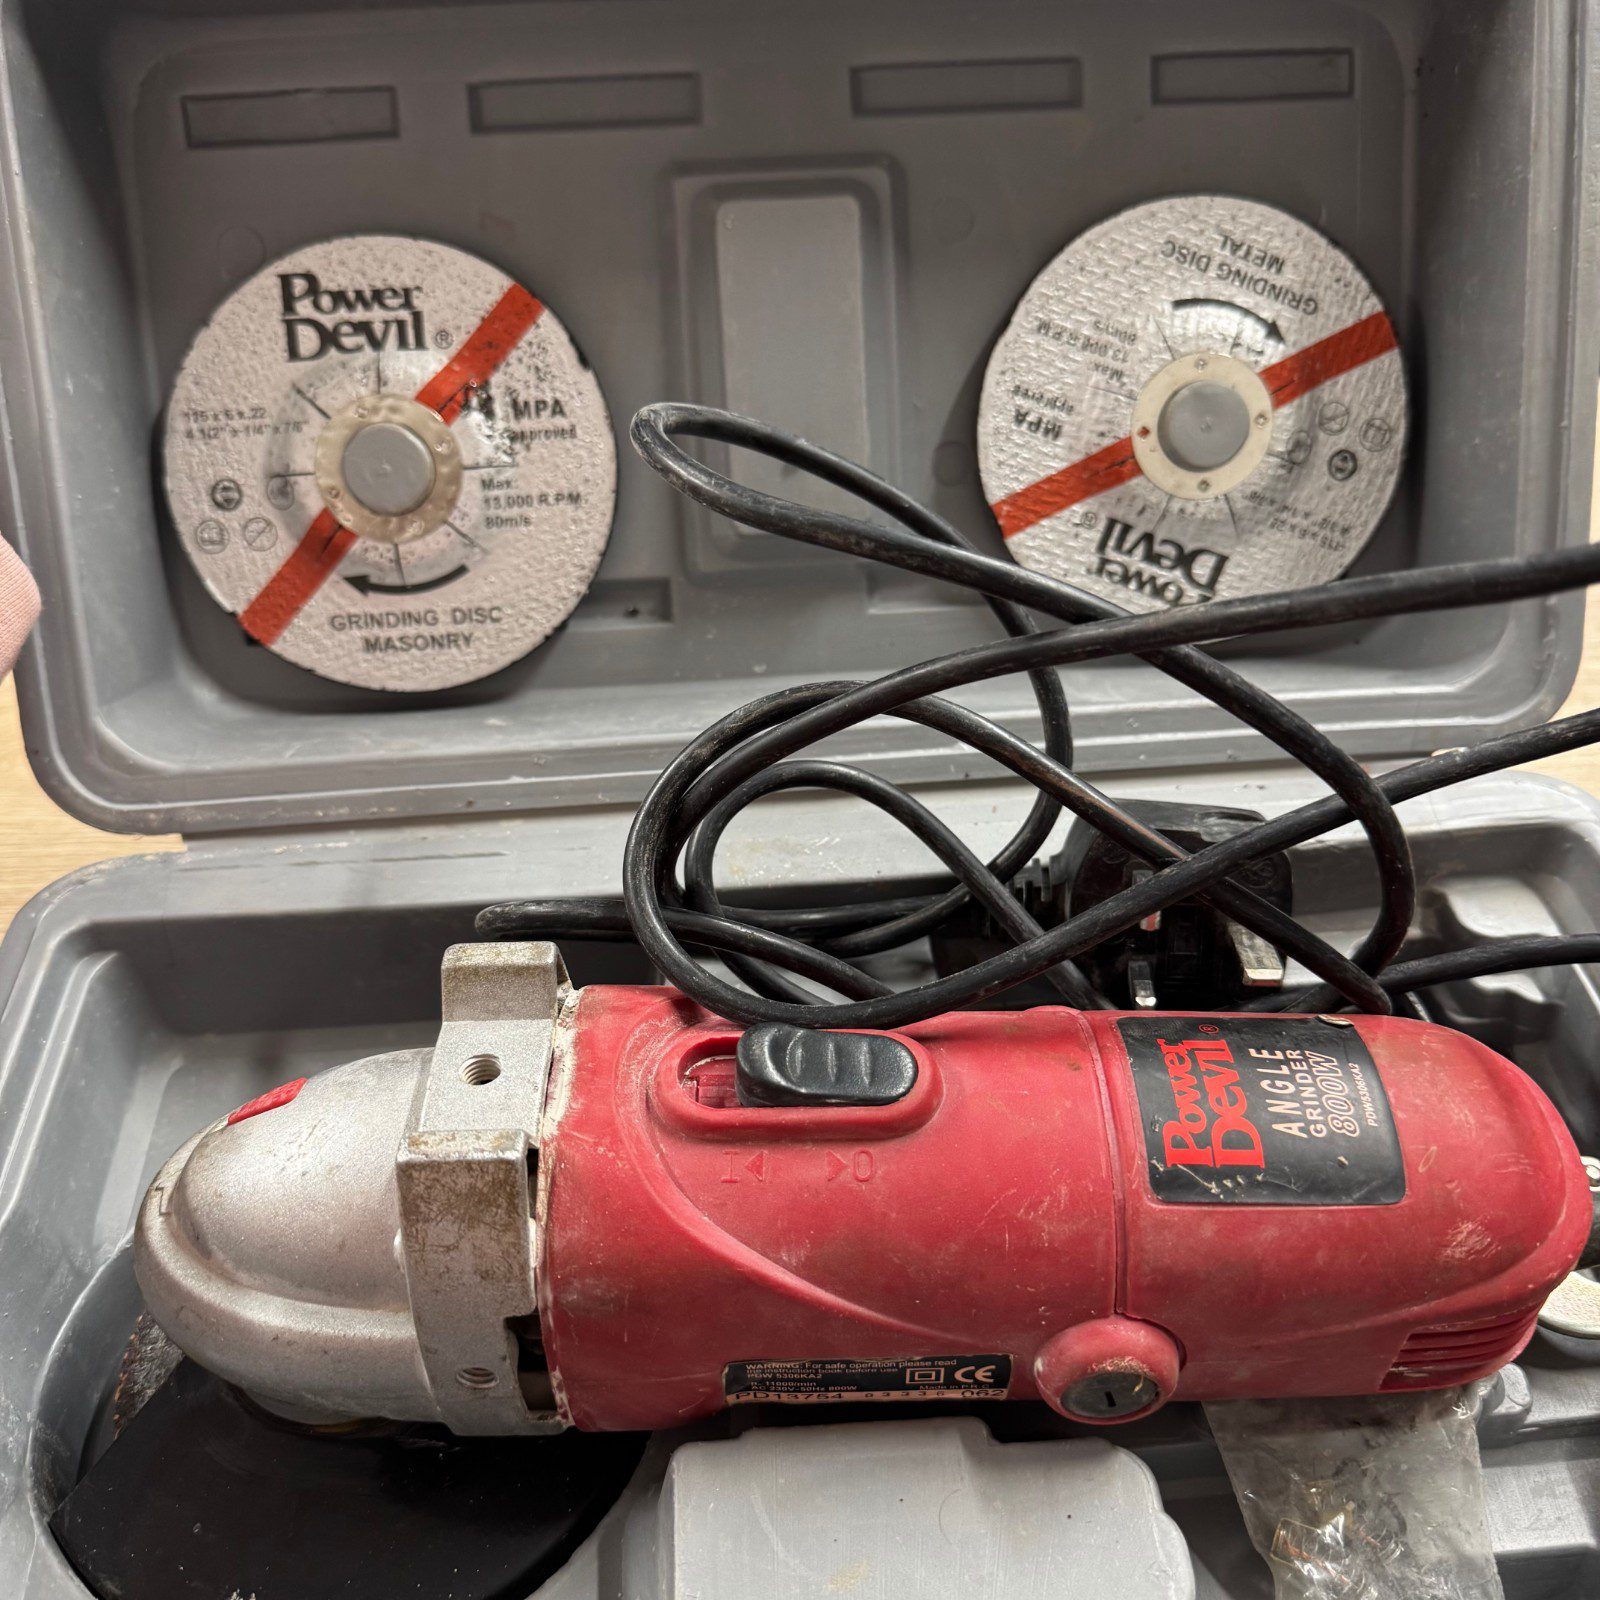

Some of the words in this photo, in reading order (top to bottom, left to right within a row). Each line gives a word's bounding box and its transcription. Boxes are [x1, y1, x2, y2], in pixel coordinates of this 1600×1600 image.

[1161, 240, 1211, 273] DISC
[1219, 234, 1285, 275] METAL
[277, 271, 424, 317] Power
[1216, 262, 1318, 315] GRINDING
[282, 311, 430, 363] Devil
[511, 397, 567, 420] MPA
[1014, 407, 1062, 440] MPA
[1096, 517, 1229, 592] Devil
[1086, 557, 1212, 606] ower
[330, 609, 439, 631] GRINDING
[452, 606, 503, 625] DISC
[363, 632, 473, 653] MASONRY
[1156, 1038, 1214, 1168] Power
[1184, 1039, 1265, 1169] Devil
[1249, 1048, 1308, 1138] ANGLE
[1285, 1050, 1327, 1137] GRINDER
[1304, 1050, 1360, 1137] 800W
[849, 1361, 896, 1370] operation
[899, 1360, 932, 1369] please
